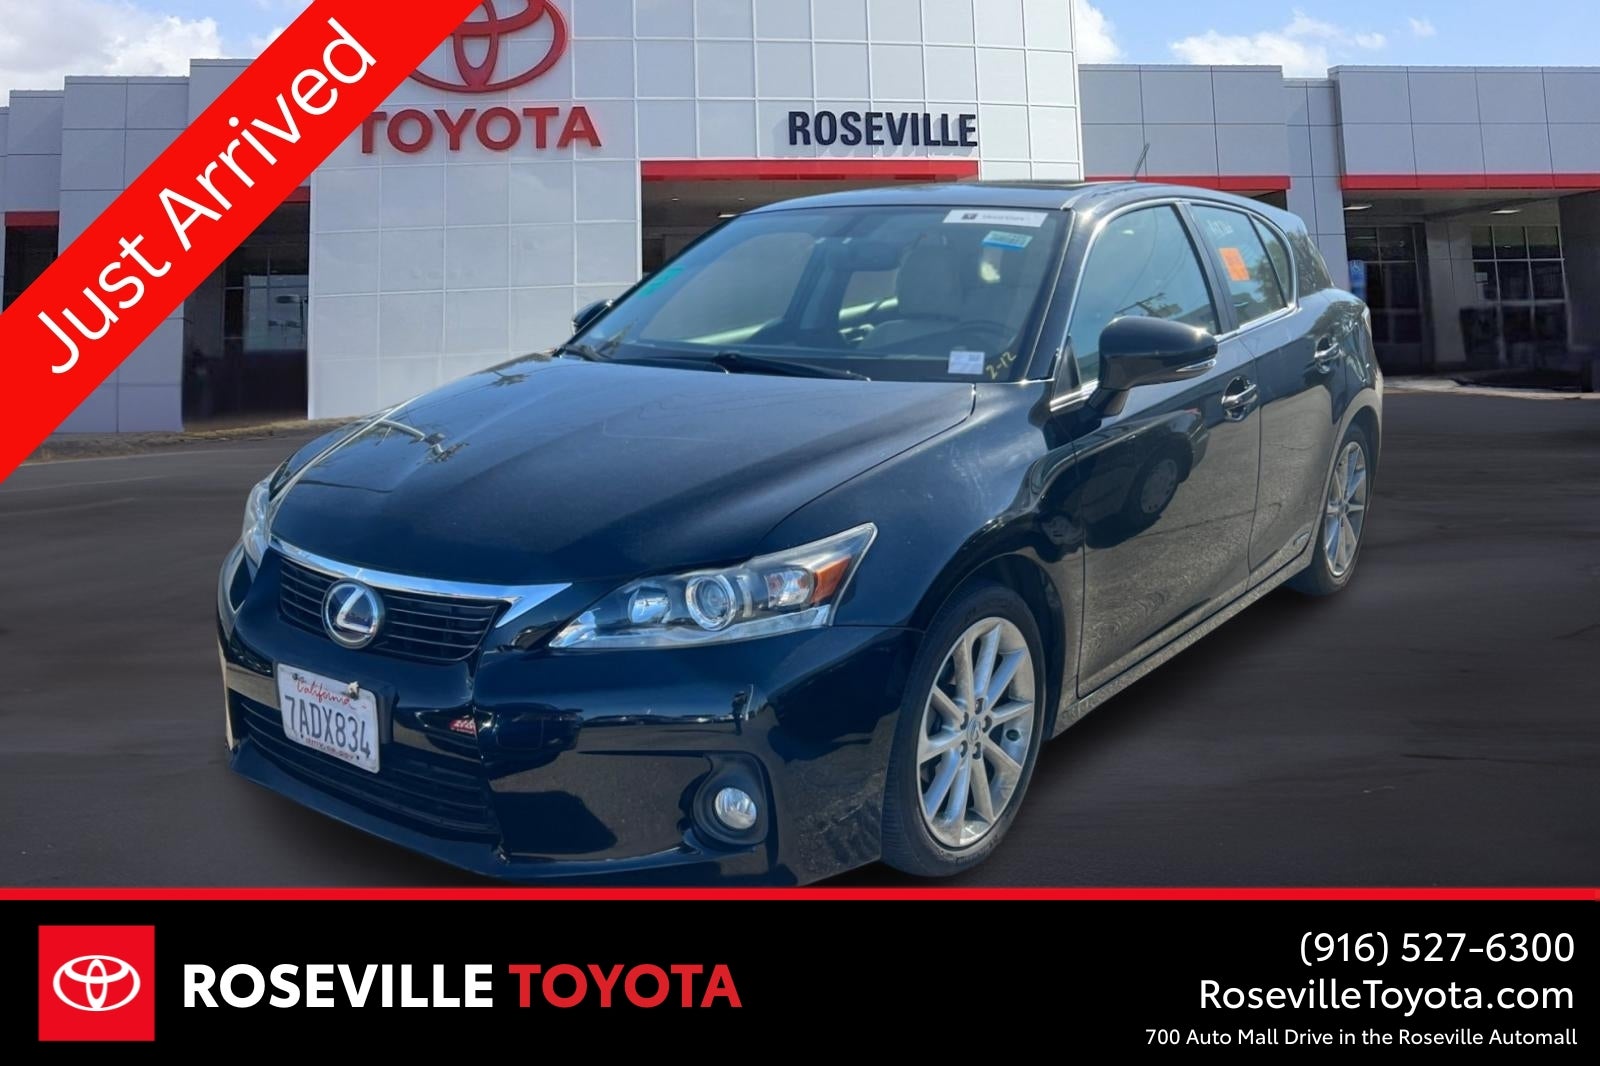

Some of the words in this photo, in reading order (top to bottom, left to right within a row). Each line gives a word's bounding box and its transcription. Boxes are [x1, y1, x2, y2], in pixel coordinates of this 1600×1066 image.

[360, 106, 602, 154] TOYOTA
[788, 111, 978, 147] ROSEVILLE
[296, 675, 354, 706] California
[284, 693, 372, 760] 7ADX834
